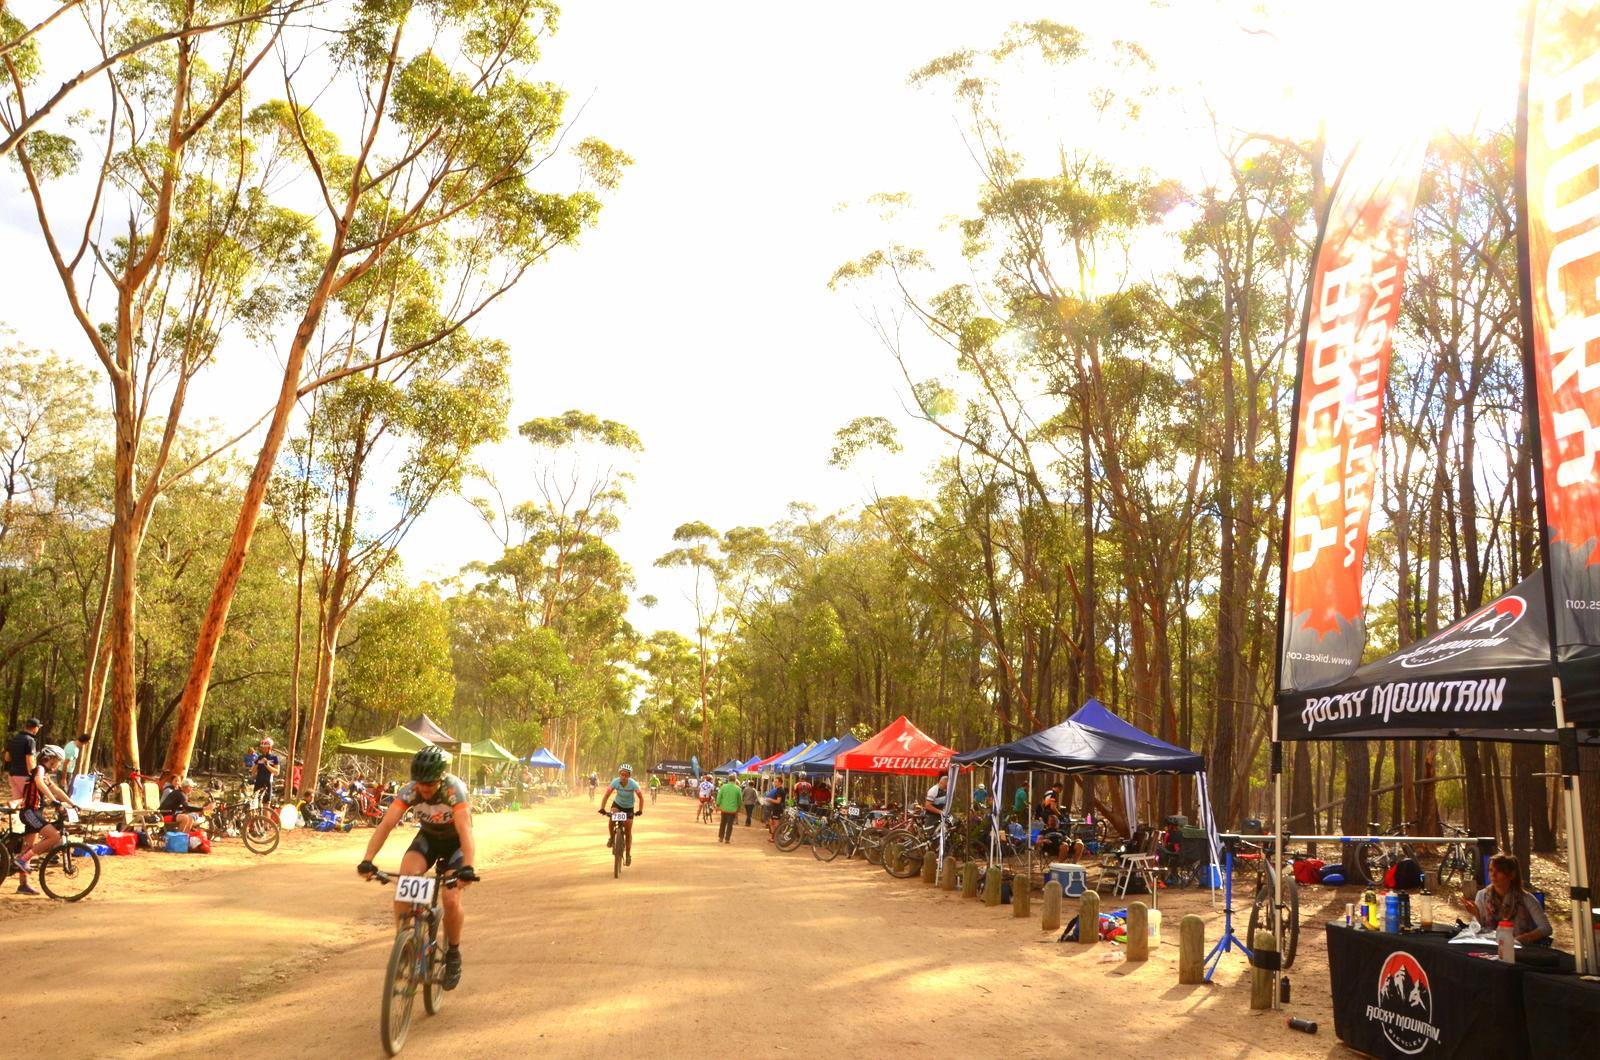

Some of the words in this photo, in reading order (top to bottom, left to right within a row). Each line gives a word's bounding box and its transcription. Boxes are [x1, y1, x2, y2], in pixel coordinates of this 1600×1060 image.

[1301, 687, 1368, 732] ROCKY
[1371, 677, 1506, 723] MOUNTAIN
[871, 756, 951, 769] SPECIALIZED
[399, 879, 430, 899] 501
[1366, 1004, 1395, 1024] ROCKY
[1395, 1013, 1440, 1041] MOUNTAIN
